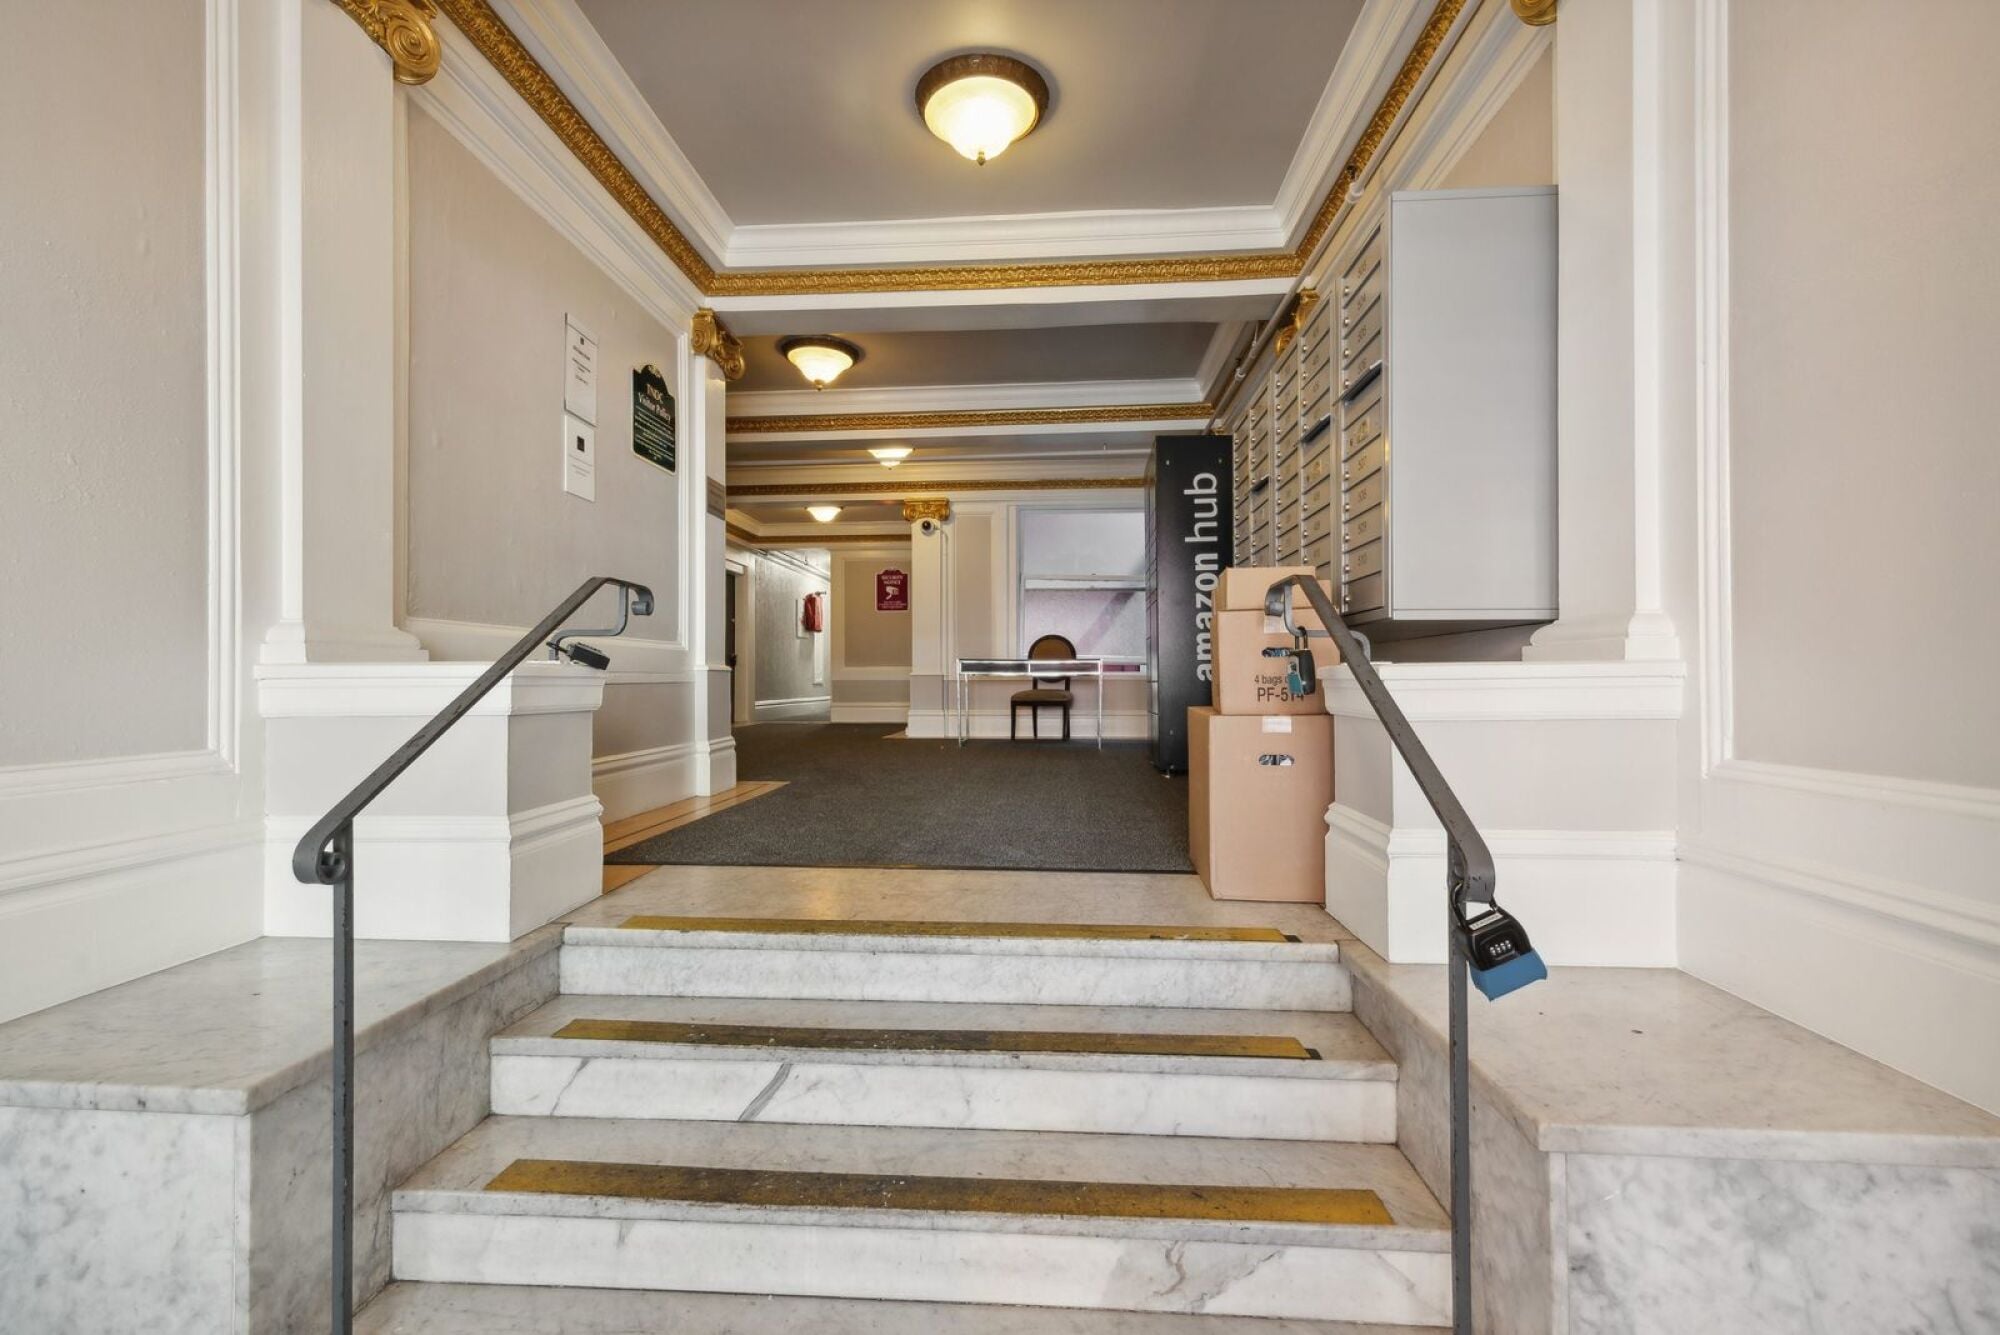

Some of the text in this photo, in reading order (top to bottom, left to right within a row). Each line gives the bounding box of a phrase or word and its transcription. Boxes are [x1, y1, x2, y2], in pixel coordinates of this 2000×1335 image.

[1184, 472, 1219, 682] amazon hub
[1254, 674, 1260, 684] 4
[1262, 674, 1283, 686] bags
